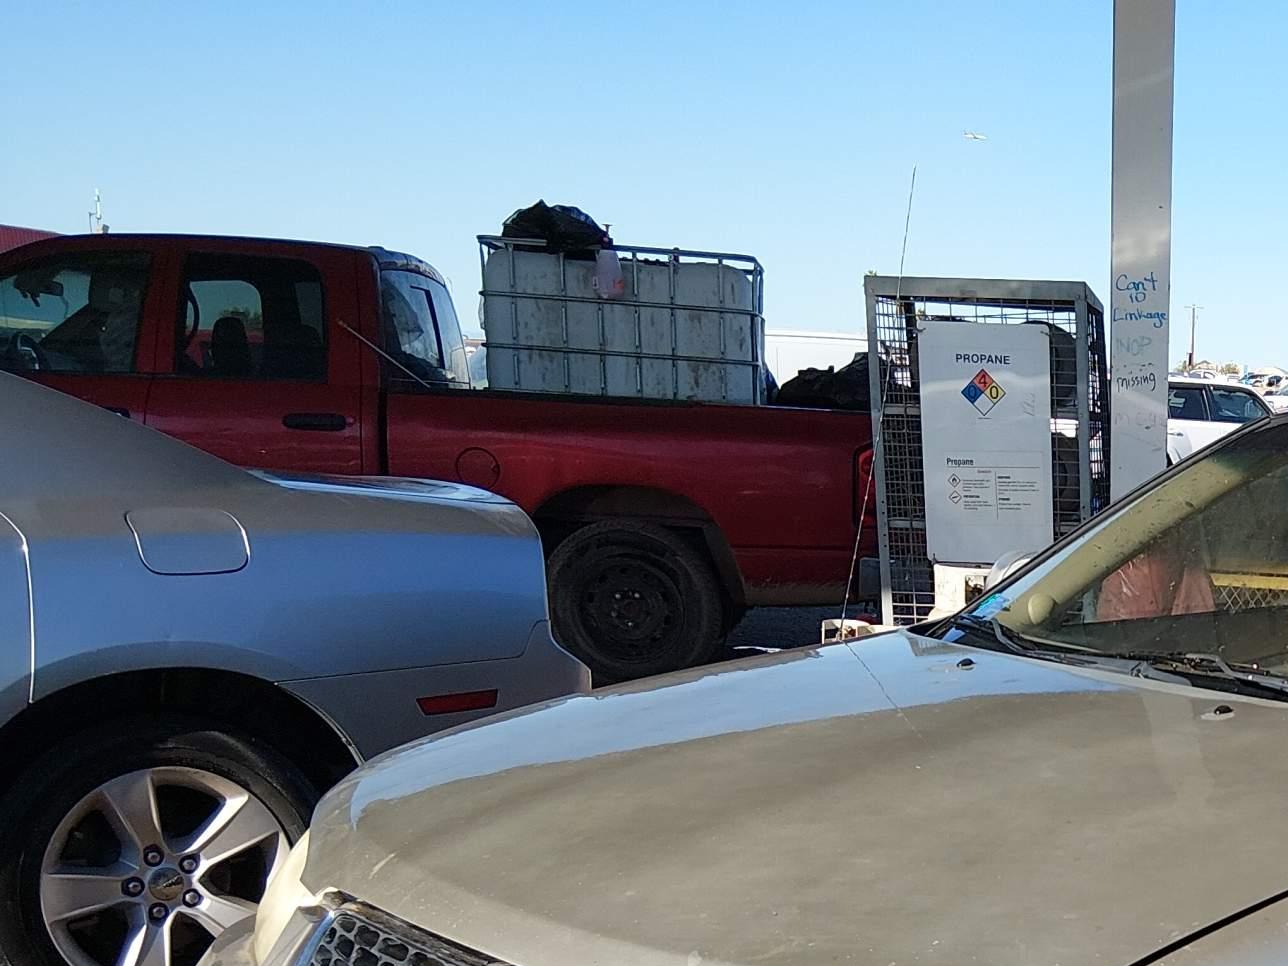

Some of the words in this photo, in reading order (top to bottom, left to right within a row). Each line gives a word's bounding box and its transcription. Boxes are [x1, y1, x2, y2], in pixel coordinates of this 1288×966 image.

[1113, 307, 1167, 328] Linkage
[955, 353, 1011, 365] PROPANE
[977, 374, 988, 387] 4
[1116, 372, 1156, 393] missing
[967, 384, 977, 400] 0
[989, 385, 999, 400] 0
[946, 457, 975, 468] Propane
